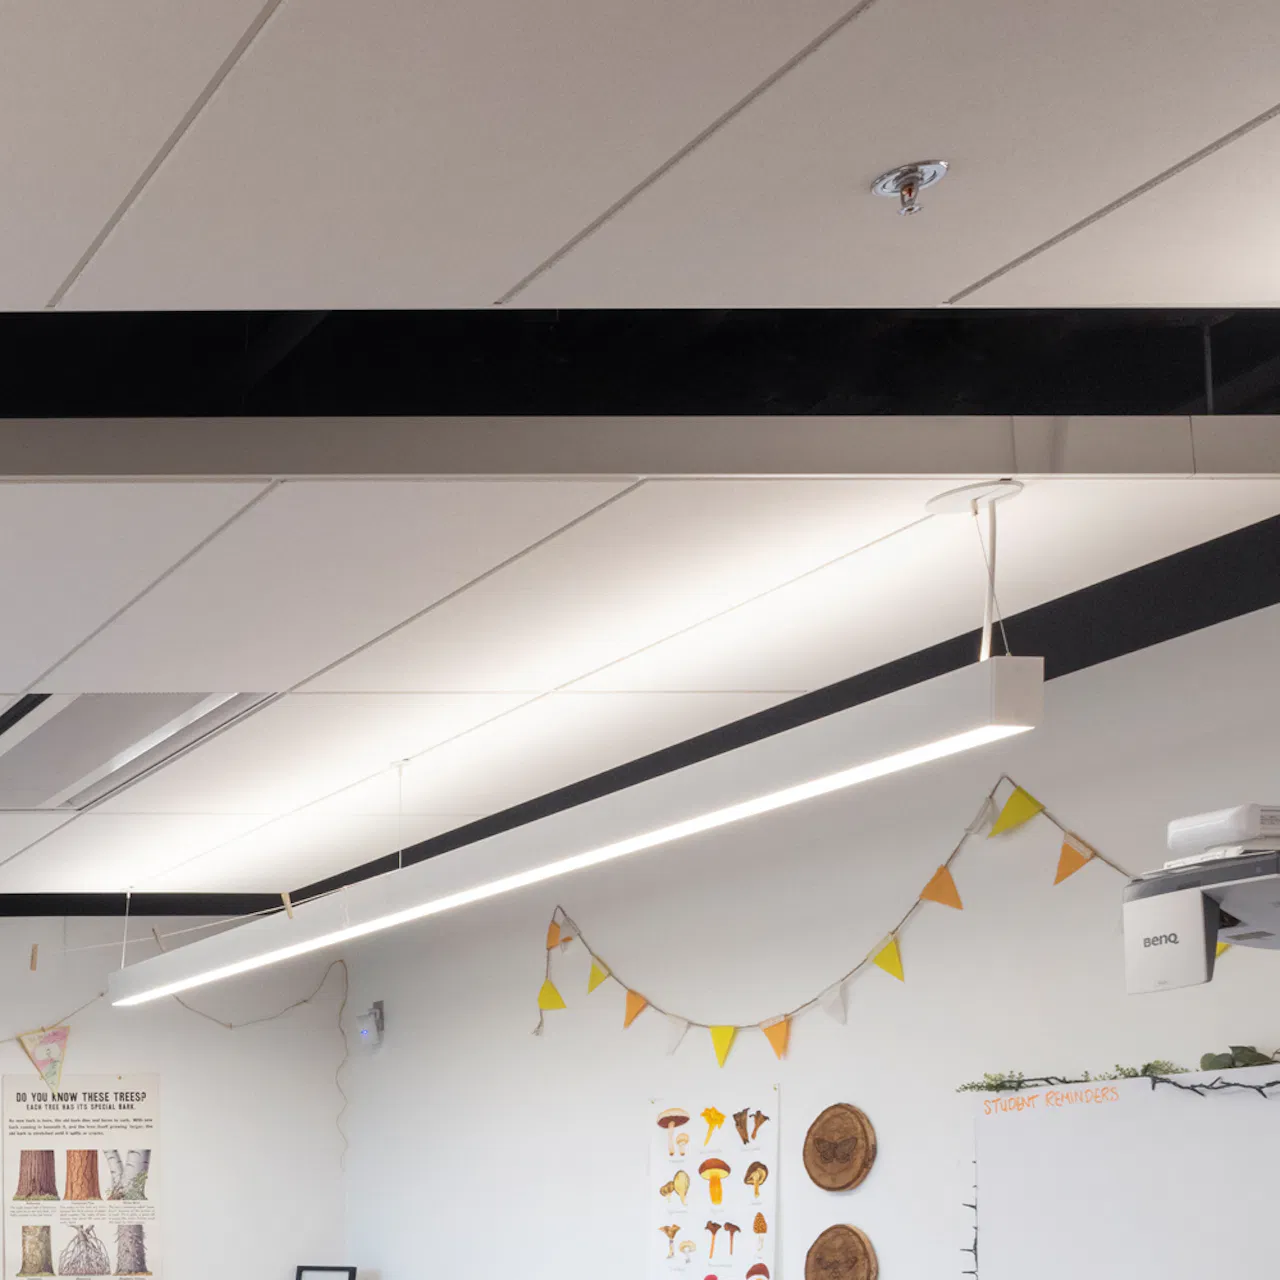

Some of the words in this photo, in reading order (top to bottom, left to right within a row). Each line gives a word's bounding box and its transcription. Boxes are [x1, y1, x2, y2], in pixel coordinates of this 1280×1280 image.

[16, 1092, 27, 1102] DO
[31, 1092, 48, 1102] YOU
[52, 1092, 78, 1102] KNOW
[82, 1092, 110, 1102] THESE
[114, 1092, 147, 1102] TREES?
[983, 1094, 1040, 1115] STUDENT
[1045, 1086, 1119, 1107] REMINDERS
